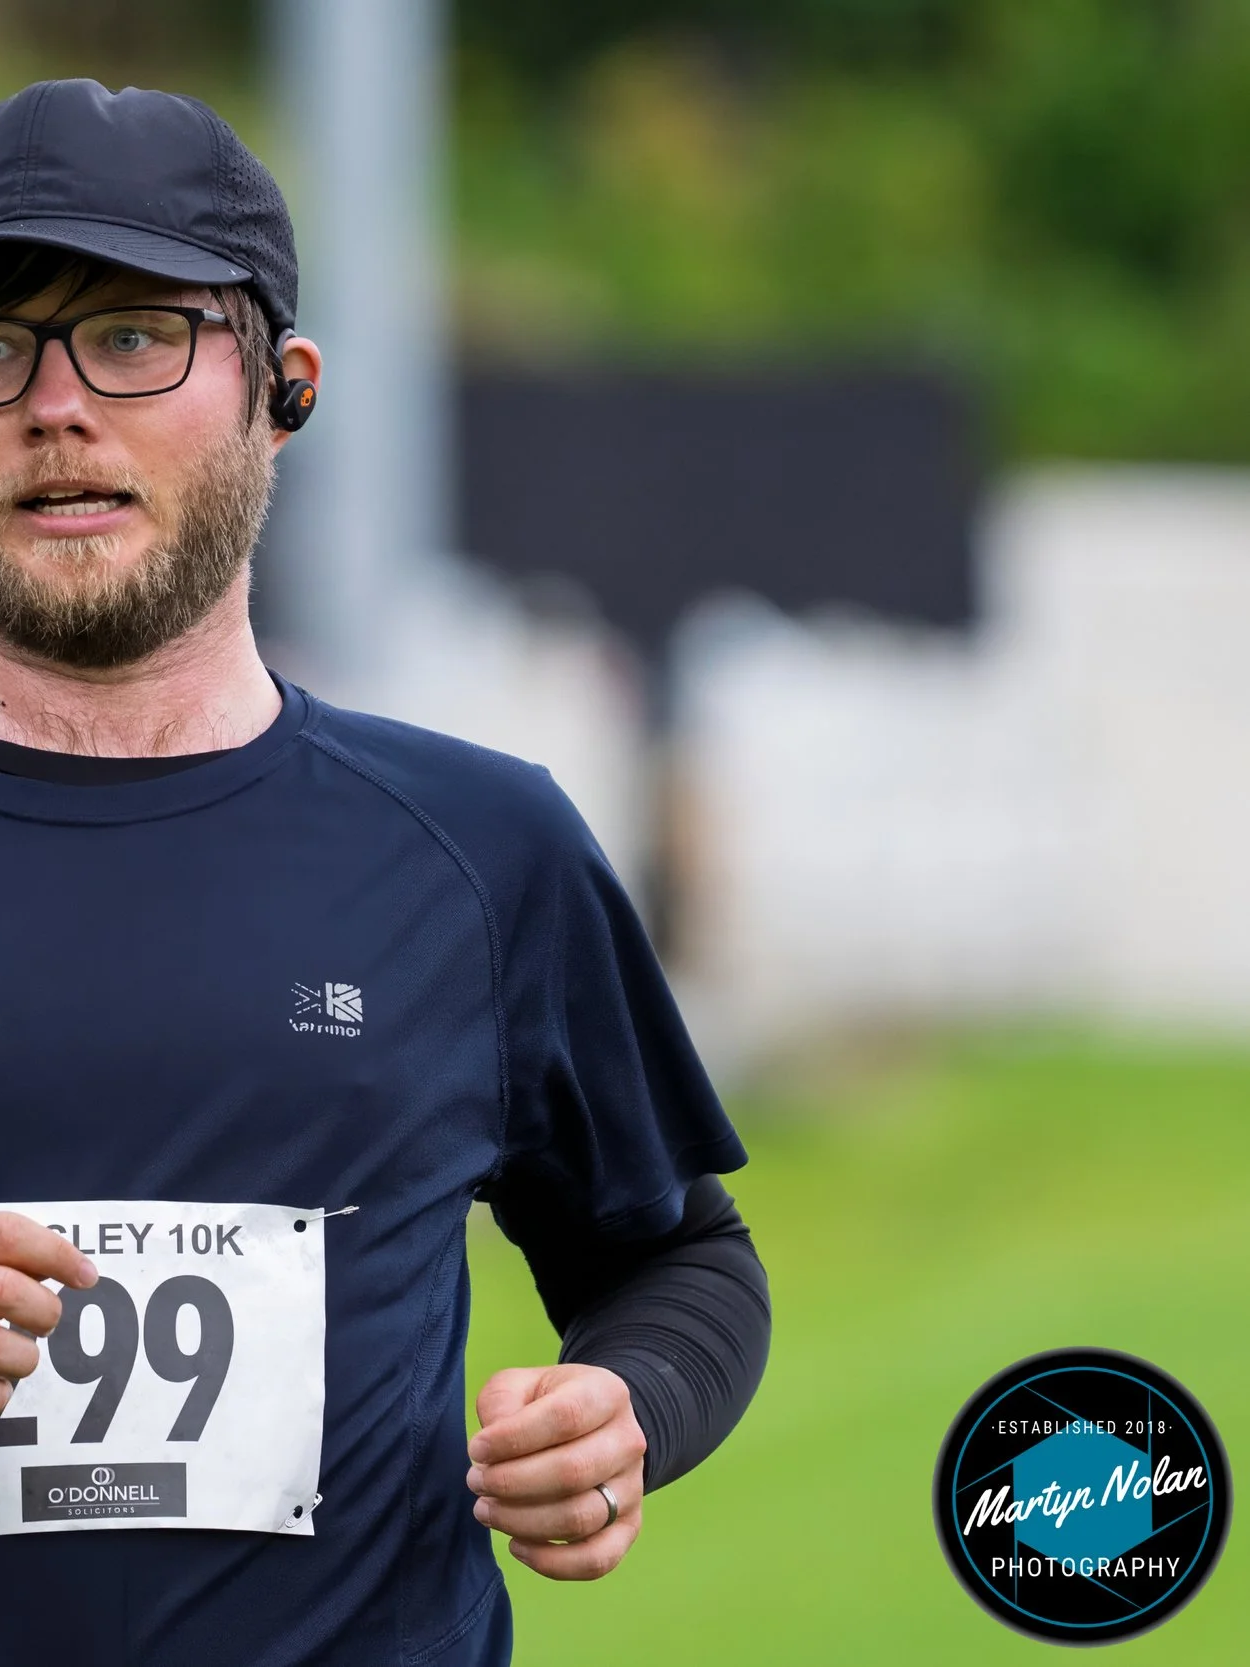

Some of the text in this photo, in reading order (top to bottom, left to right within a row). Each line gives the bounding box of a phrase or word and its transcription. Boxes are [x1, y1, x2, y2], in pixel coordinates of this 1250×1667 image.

[46, 1223, 245, 1257] LEY 10K
[48, 1485, 160, 1504] O'DONNELL
[67, 1506, 136, 1516] SOLICITORS
